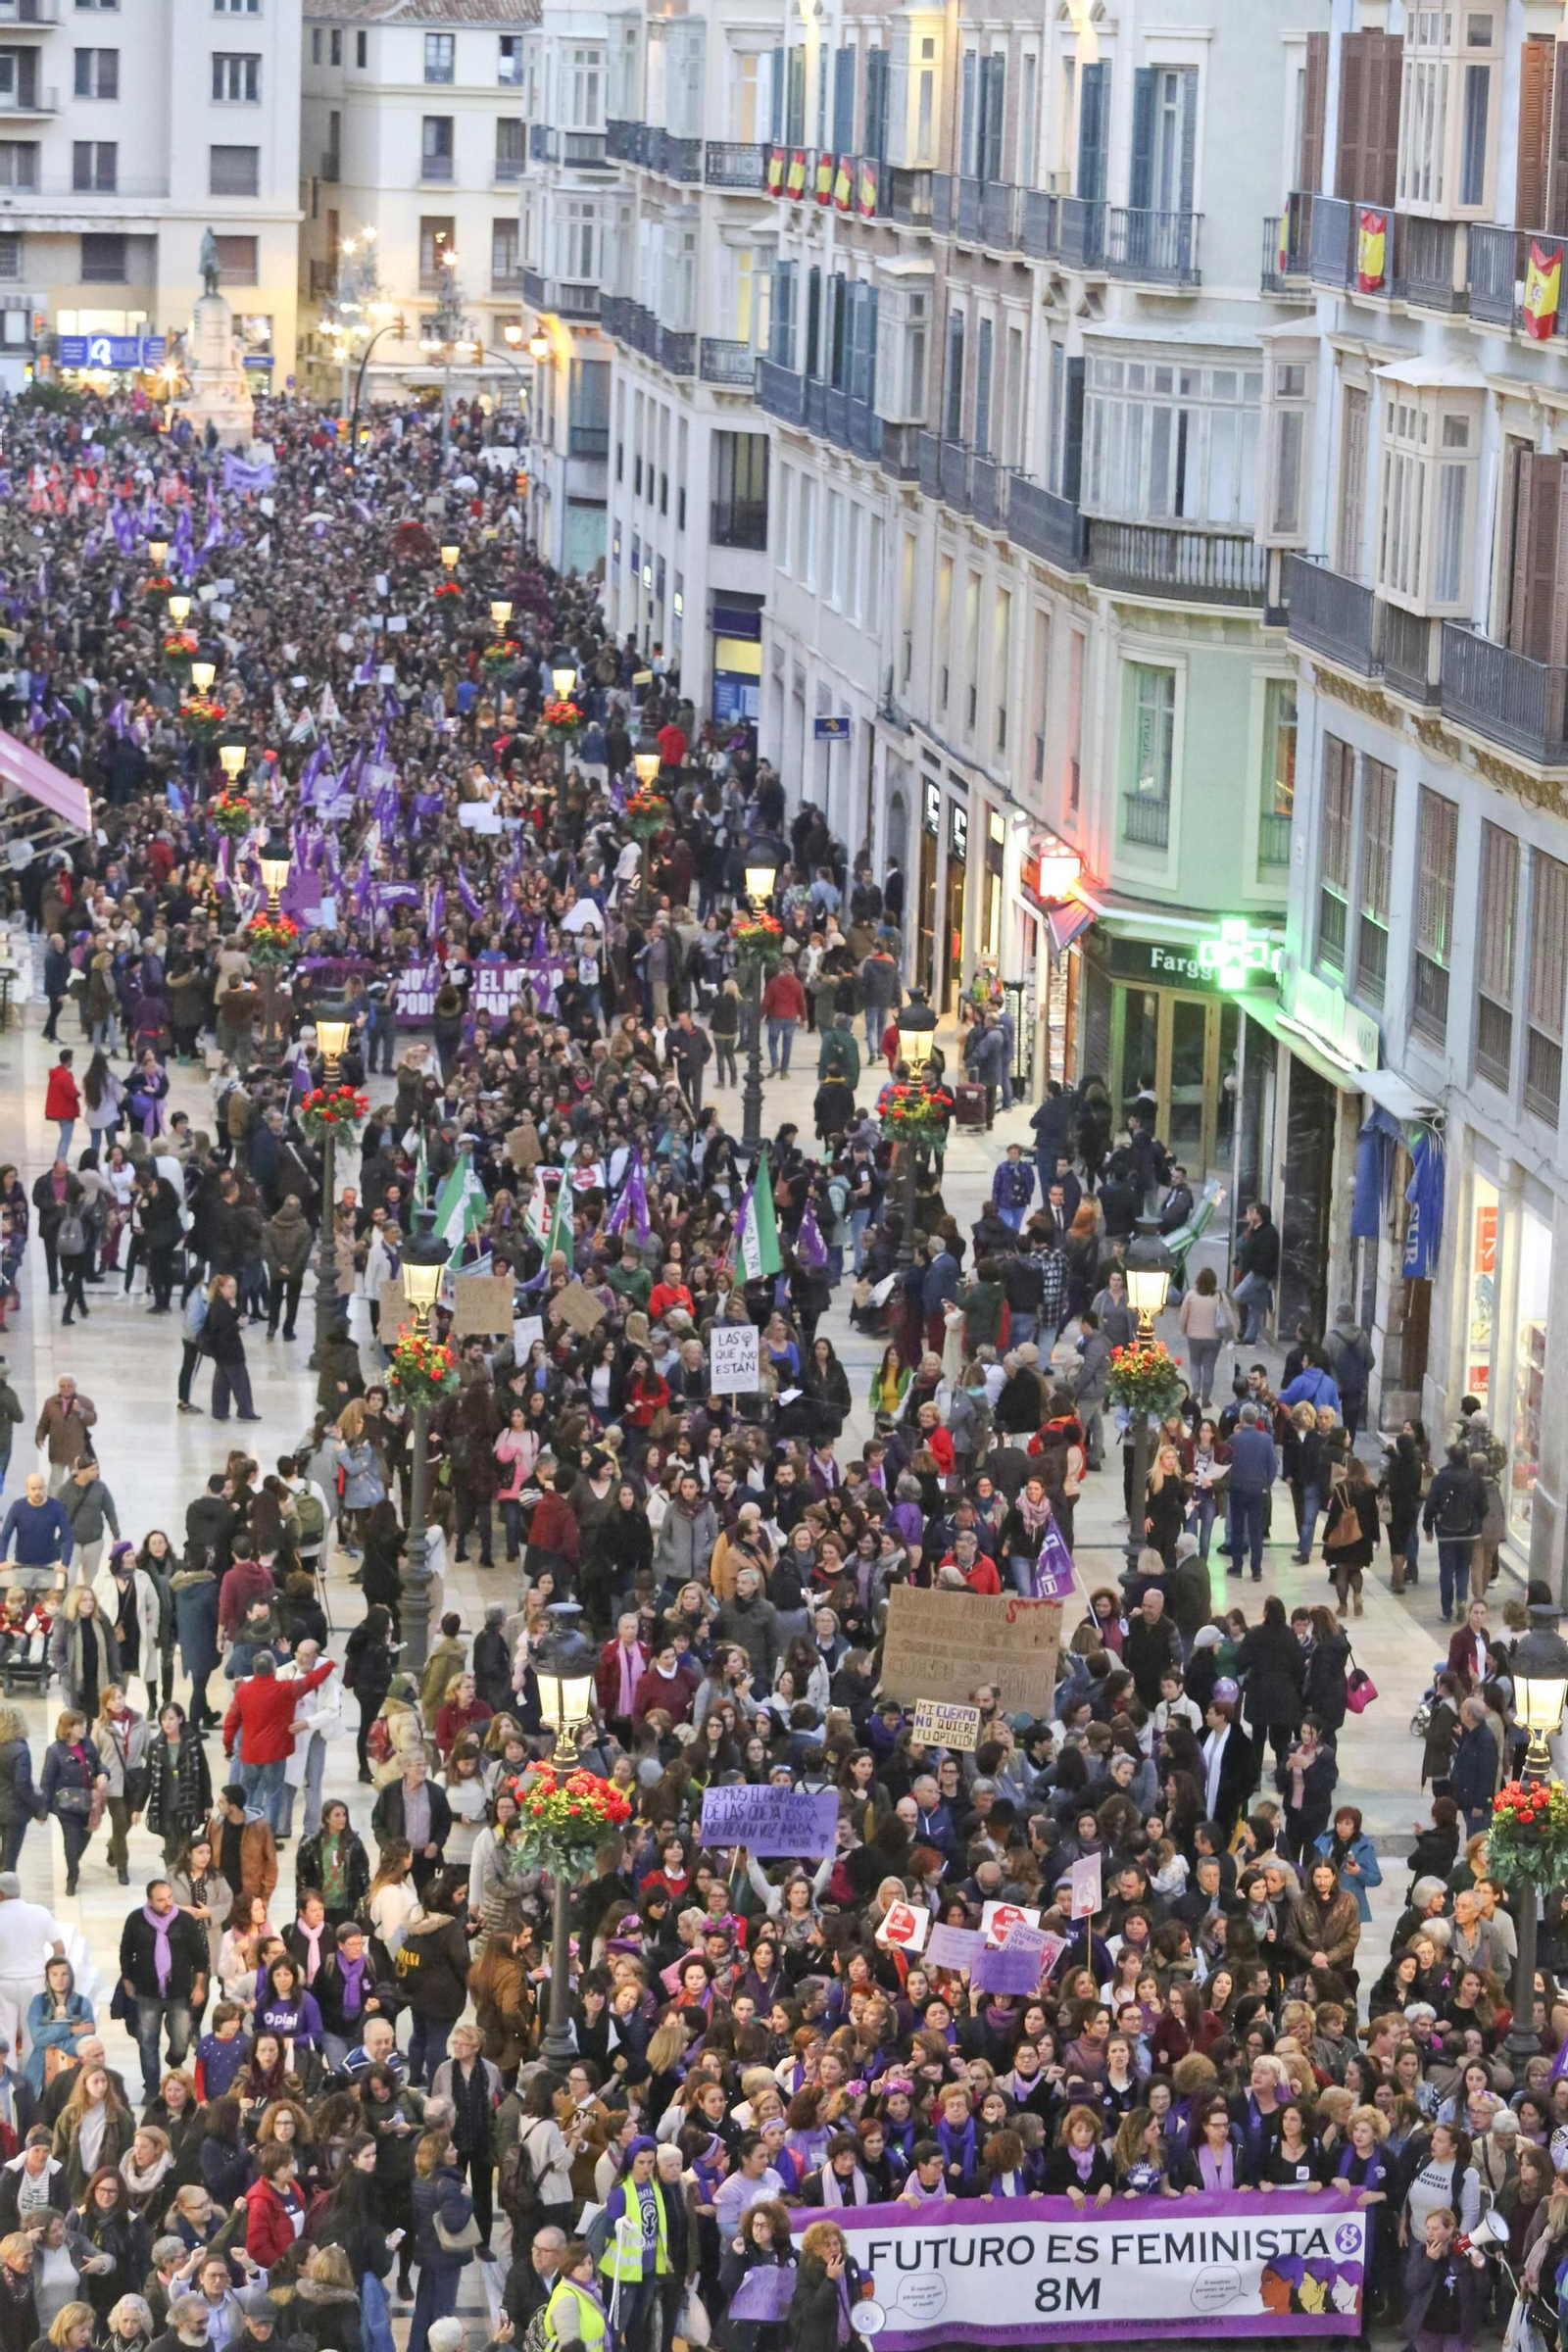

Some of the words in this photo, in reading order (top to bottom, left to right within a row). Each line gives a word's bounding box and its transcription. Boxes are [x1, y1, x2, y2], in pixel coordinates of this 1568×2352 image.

[479, 969, 501, 992] EL
[718, 1331, 740, 1347] LAS
[715, 1348, 736, 1360] QUE
[741, 1350, 758, 1361] NO
[918, 1703, 935, 1715] MI
[936, 1704, 977, 1722] CUERPO
[915, 1715, 932, 1728] NO
[938, 1718, 977, 1735] QUIERE
[916, 1729, 931, 1740] TU
[708, 1787, 748, 1802] SOMOS
[751, 1787, 762, 1803] EL
[705, 1804, 721, 1821] DE
[724, 1804, 744, 1821] LAS
[748, 1804, 768, 1821] QUE
[769, 1805, 781, 1821] YA
[702, 1821, 721, 1837] NO
[722, 1821, 758, 1838] TIENEN
[760, 1822, 779, 1838] VOZ
[1010, 1936, 1024, 1946] SER
[1013, 1929, 1043, 1945] QUIERO
[868, 2234, 1035, 2271] FUTURO
[1047, 2234, 1100, 2264] ES
[1111, 2228, 1331, 2266] FEMINISTA
[1035, 2277, 1102, 2313] 8M
